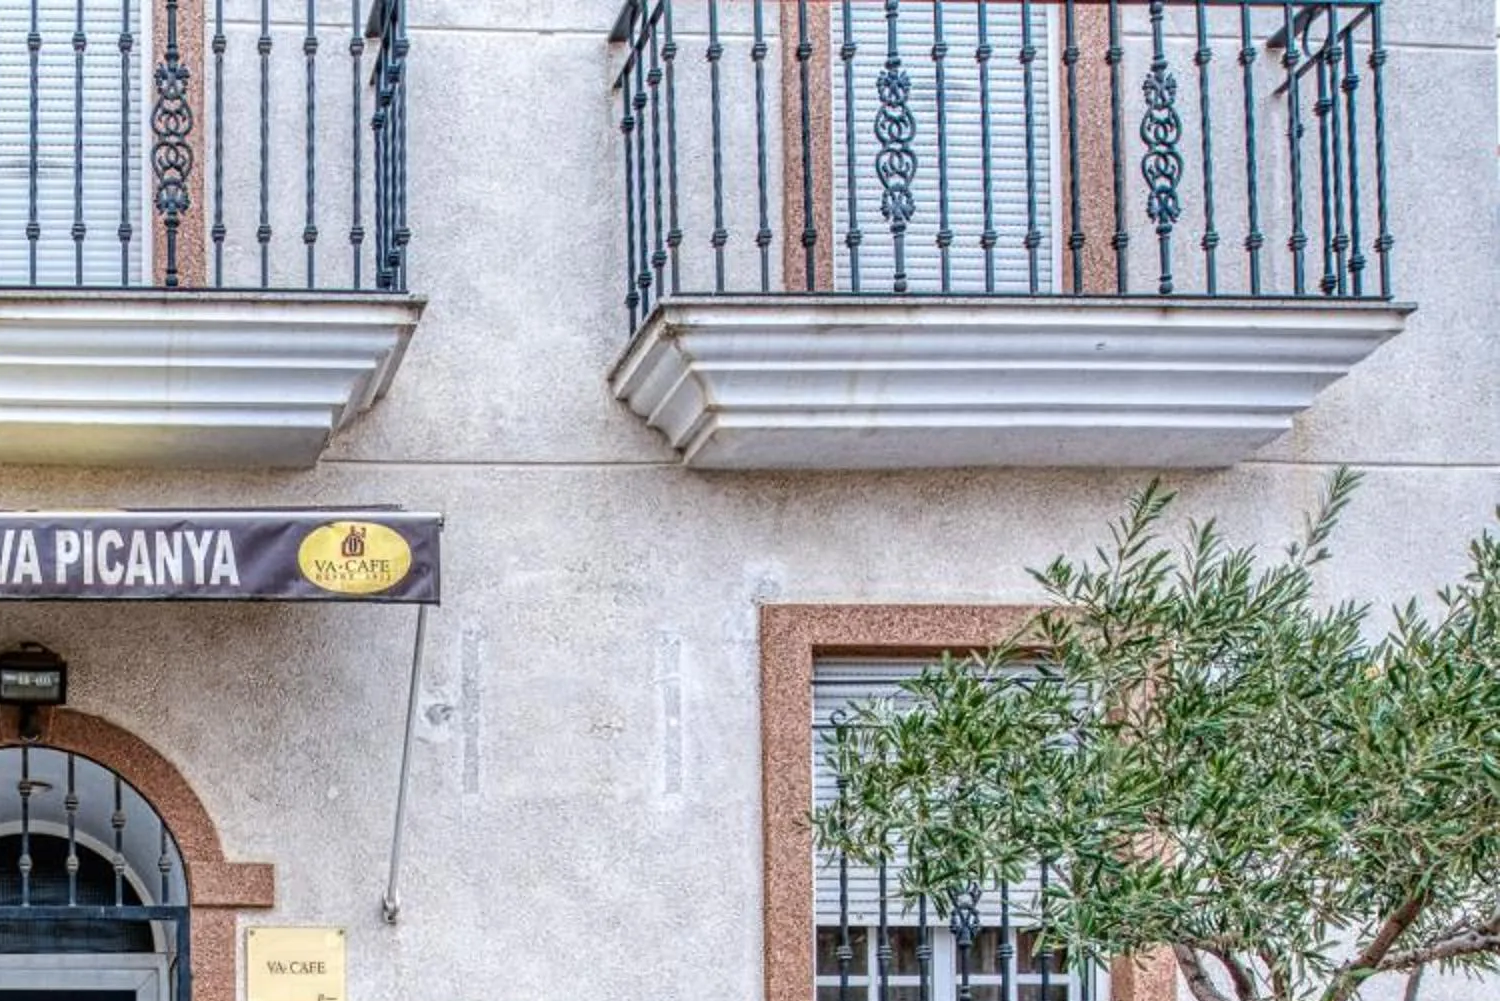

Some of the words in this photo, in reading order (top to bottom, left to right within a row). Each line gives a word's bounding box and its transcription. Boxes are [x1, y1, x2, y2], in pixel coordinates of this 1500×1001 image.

[55, 528, 241, 587] PICANYA
[345, 559, 389, 573] CAFE
[290, 960, 326, 975] CAFE
